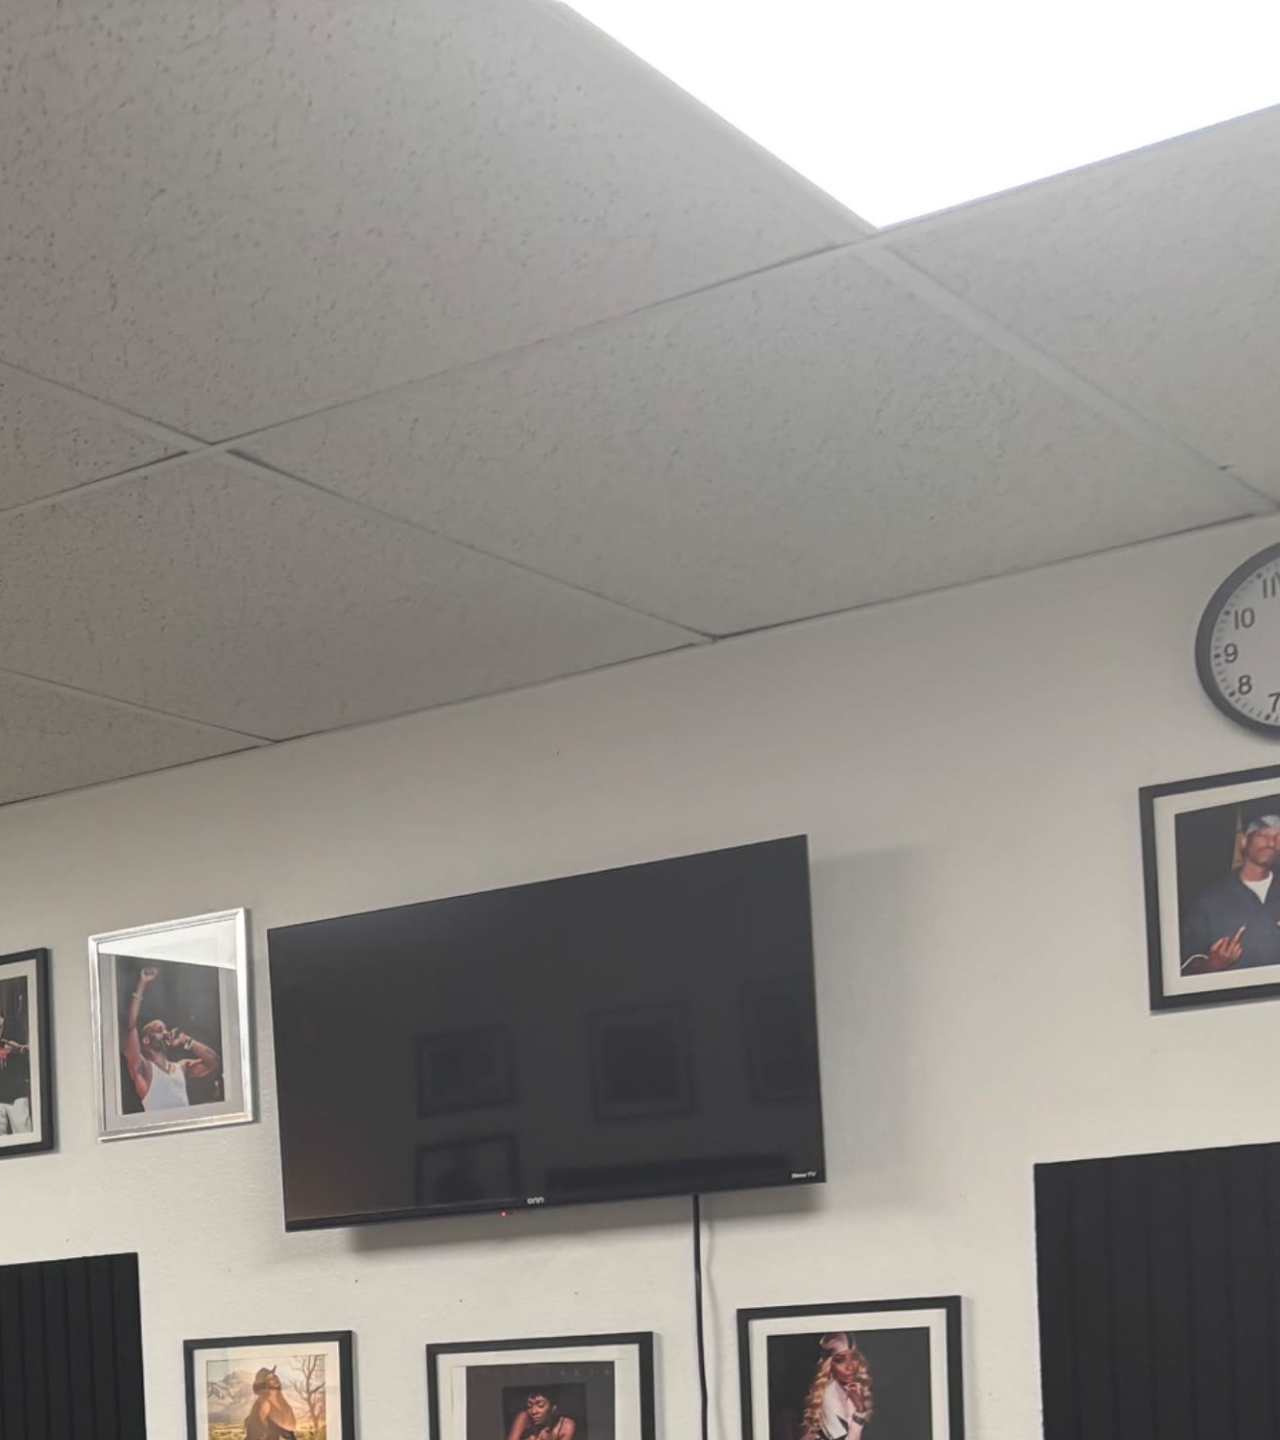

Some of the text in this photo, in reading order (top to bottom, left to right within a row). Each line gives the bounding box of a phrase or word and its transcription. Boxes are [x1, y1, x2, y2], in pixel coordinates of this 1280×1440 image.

[1234, 608, 1256, 630] 10
[1223, 643, 1239, 664] 9
[1238, 675, 1253, 696] 8
[1268, 692, 1280, 714] 7
